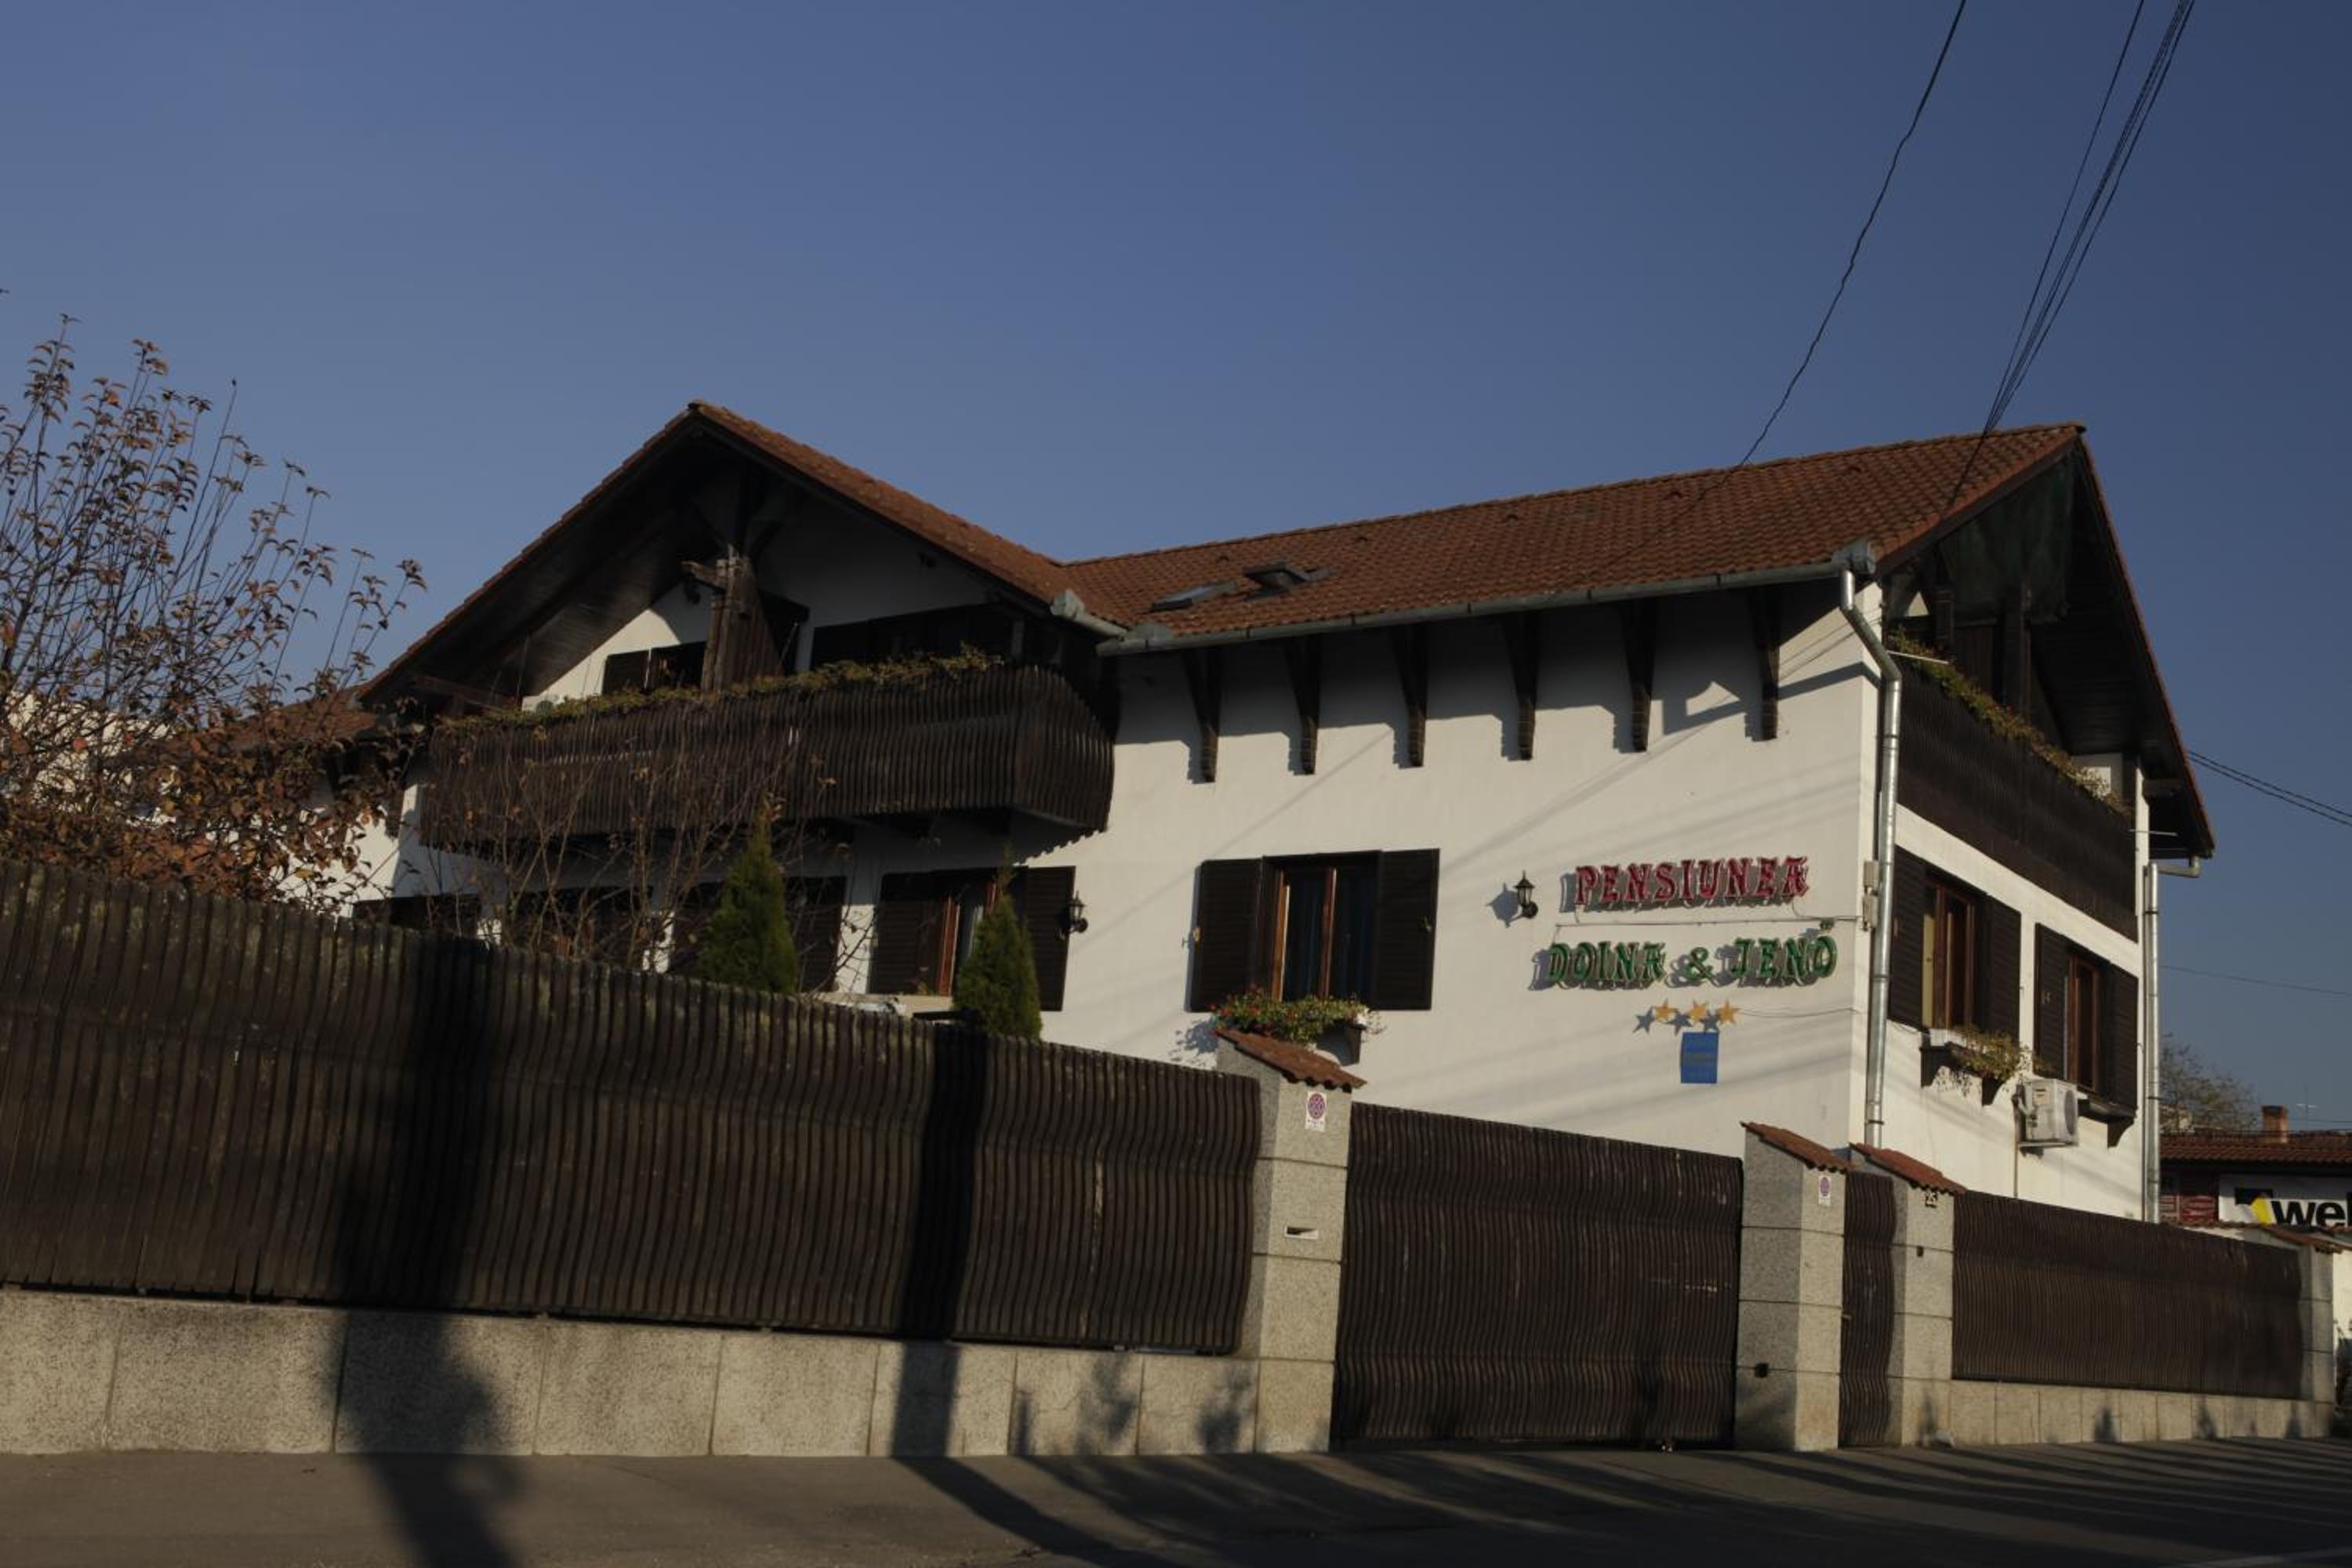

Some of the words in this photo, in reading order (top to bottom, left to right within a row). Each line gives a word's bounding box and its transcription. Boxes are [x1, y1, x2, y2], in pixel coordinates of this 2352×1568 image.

[1575, 856, 1809, 905] PENSIUNEA
[1548, 942, 1667, 982] DOINA
[1686, 946, 1716, 980] &
